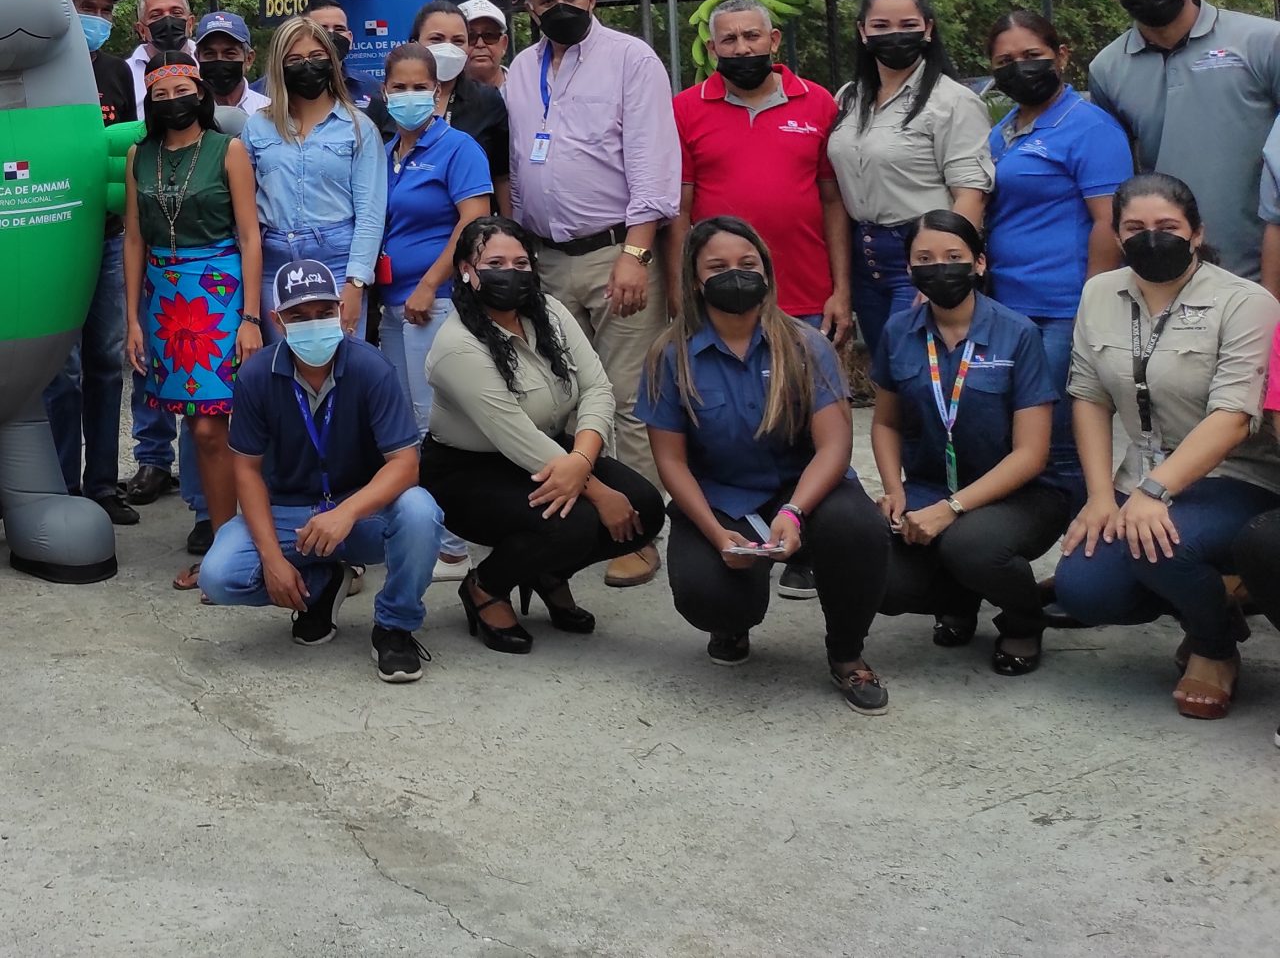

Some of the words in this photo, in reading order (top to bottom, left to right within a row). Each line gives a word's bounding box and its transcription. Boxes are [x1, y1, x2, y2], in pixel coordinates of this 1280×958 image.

[375, 41, 388, 49] DE
[15, 186, 29, 195] DE
[31, 178, 71, 193] PANAMÁ
[17, 195, 52, 206] NACIONAL
[12, 217, 26, 227] DE
[28, 210, 72, 225] AMBIENTE
